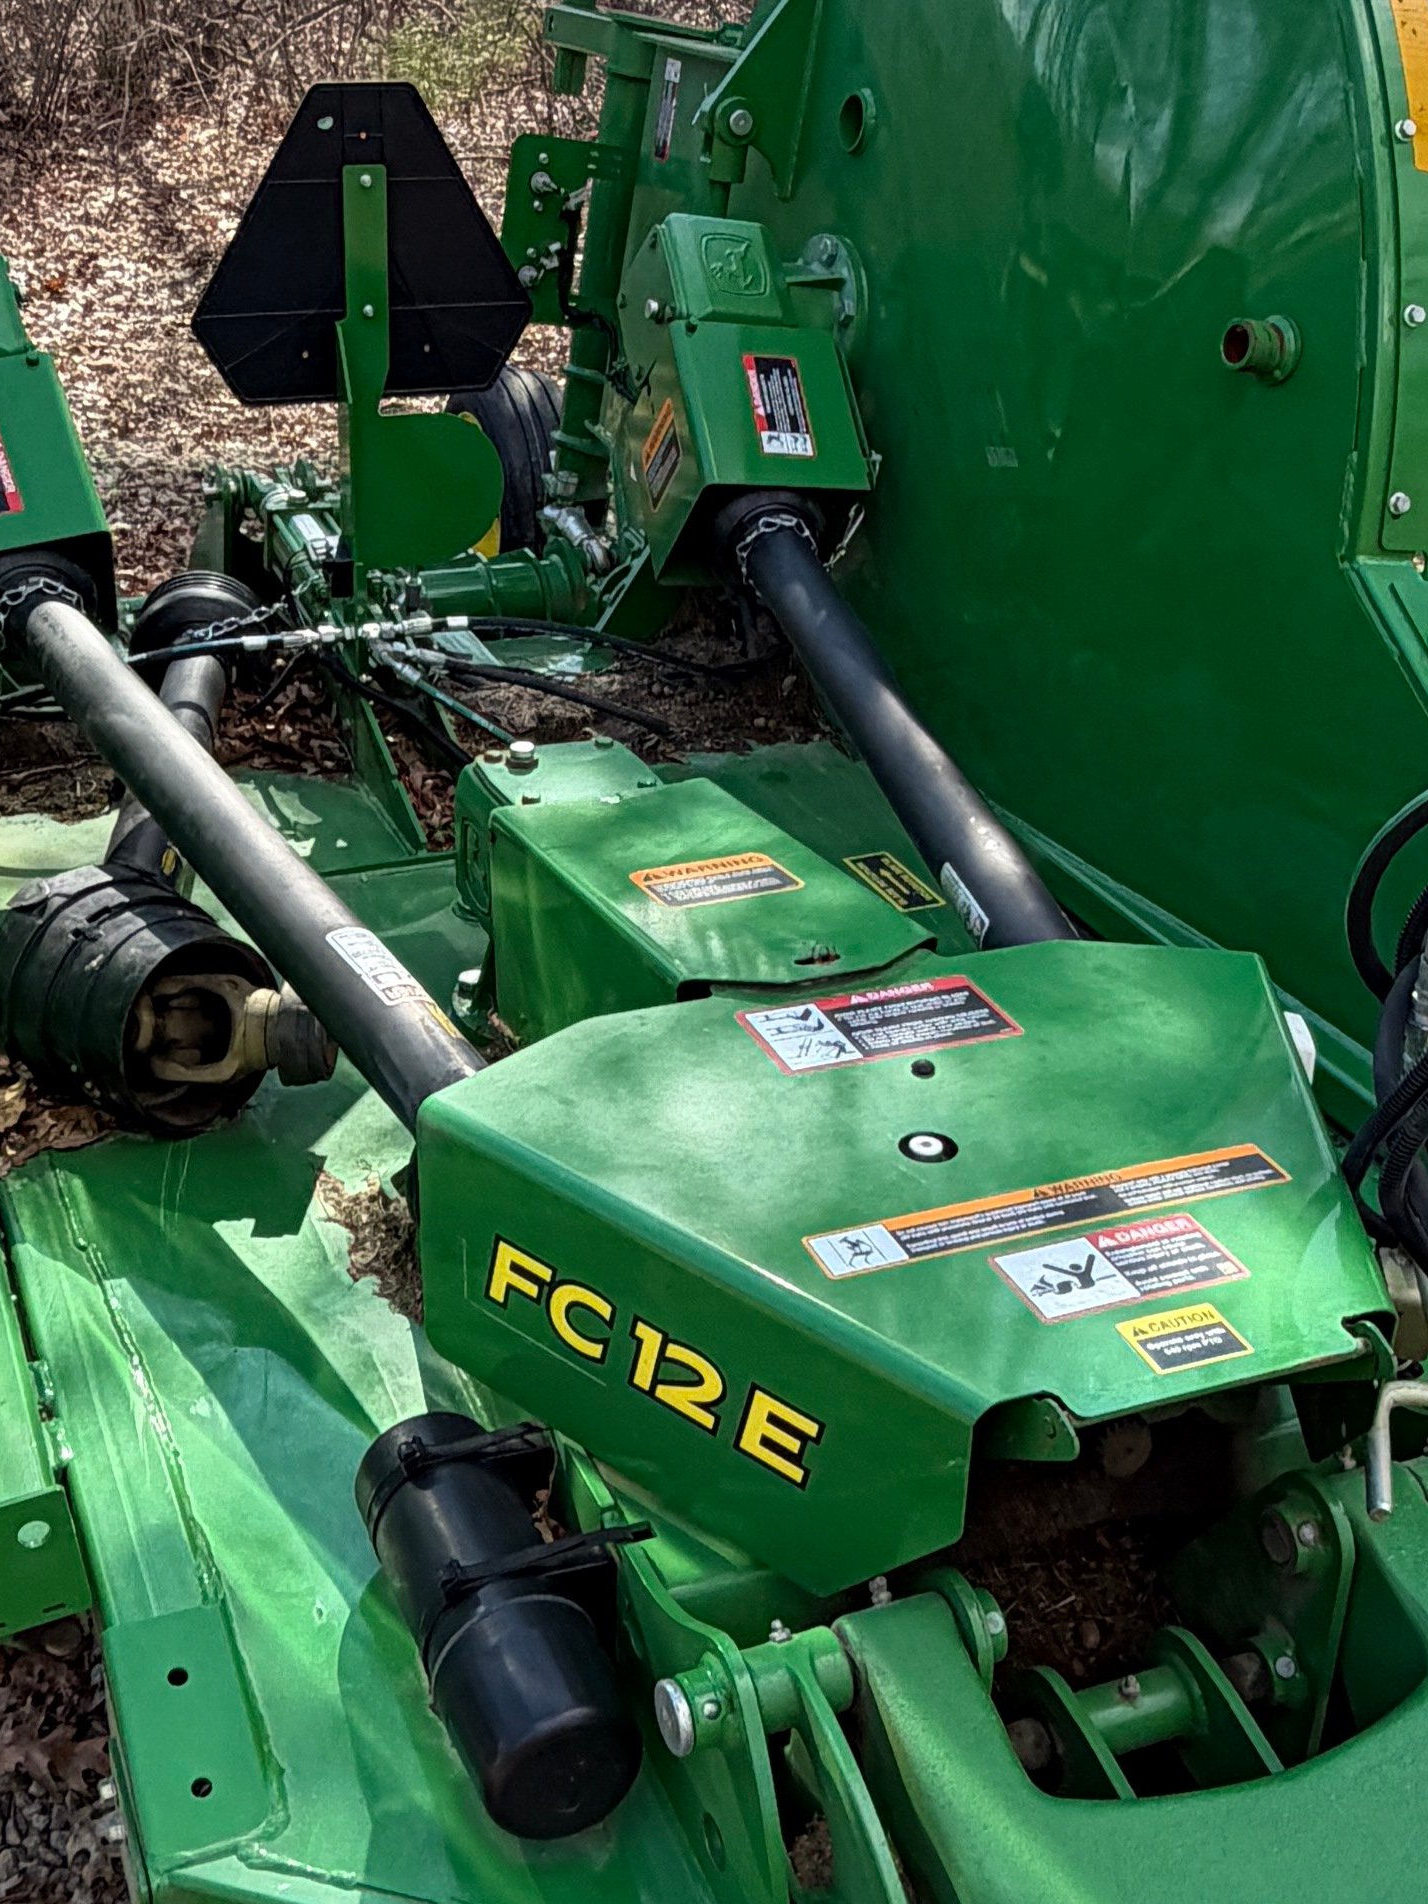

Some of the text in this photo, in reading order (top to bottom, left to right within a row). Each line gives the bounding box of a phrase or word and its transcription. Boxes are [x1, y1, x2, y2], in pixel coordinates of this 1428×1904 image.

[866, 982, 935, 1001] DANGER
[1115, 1218, 1193, 1243] DANGER
[1148, 1310, 1215, 1332] CAUTION
